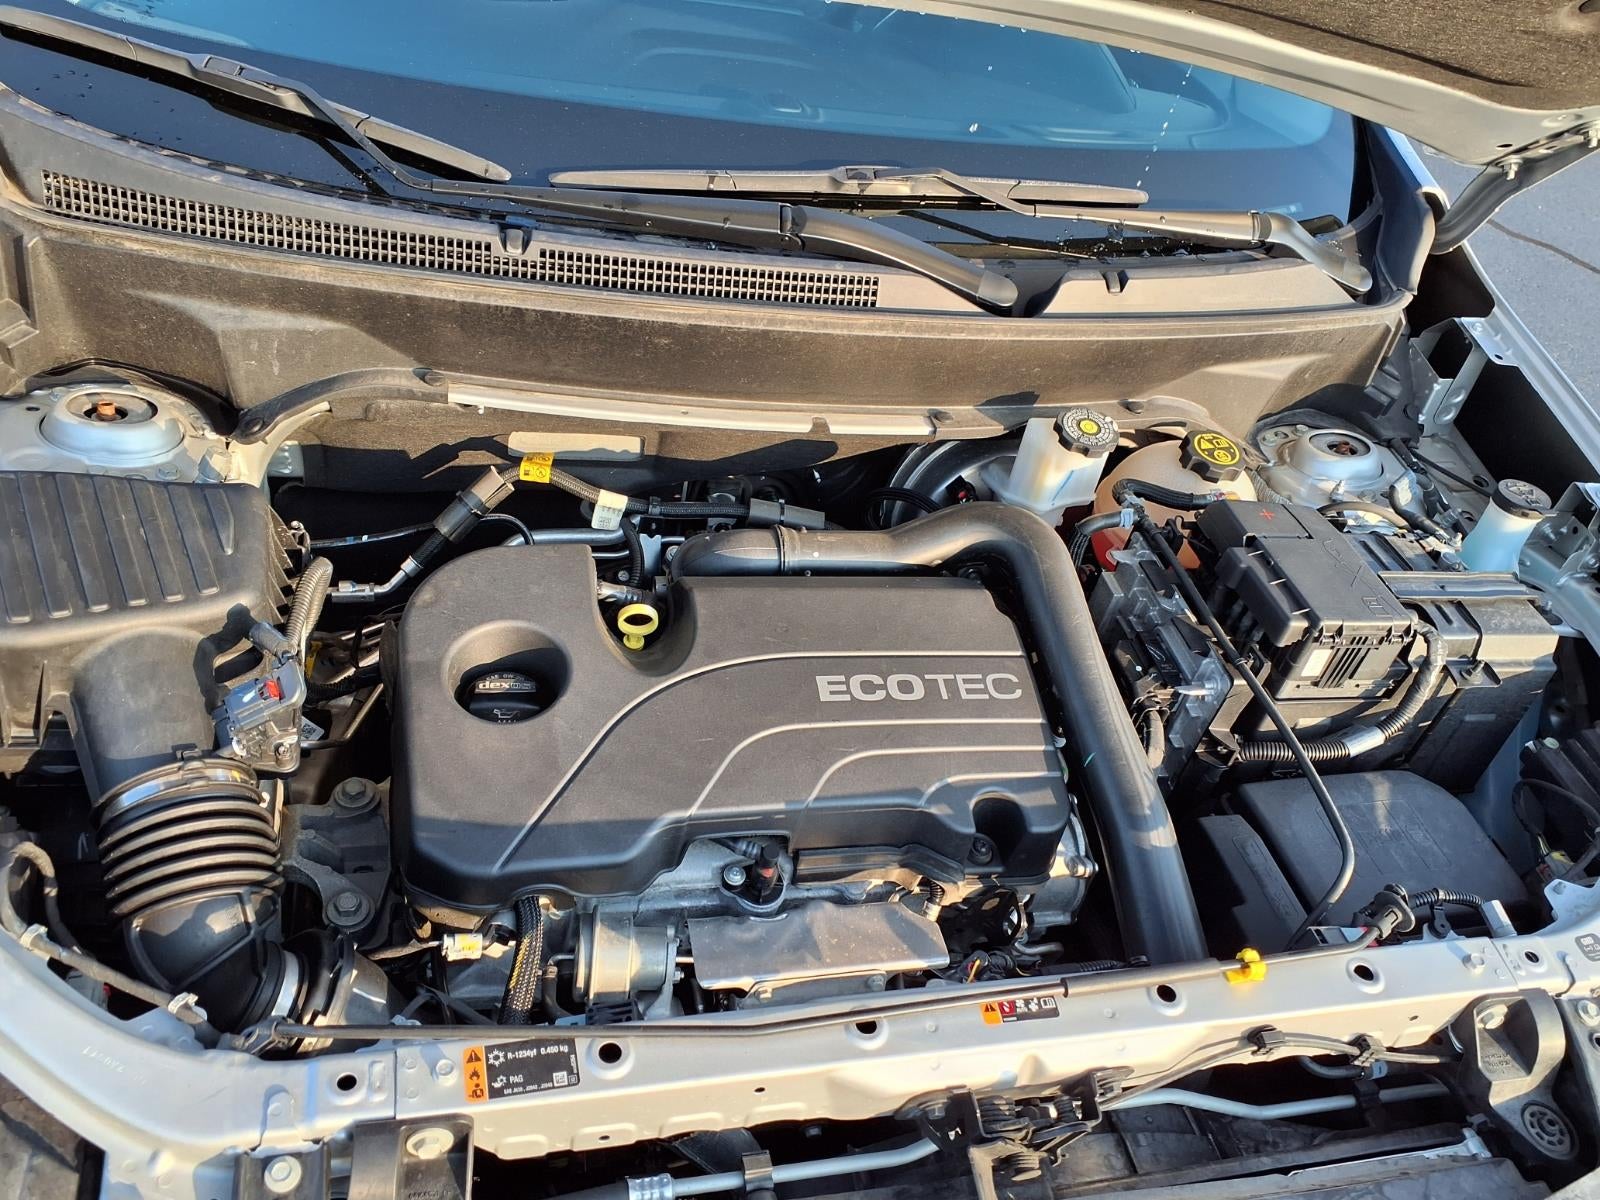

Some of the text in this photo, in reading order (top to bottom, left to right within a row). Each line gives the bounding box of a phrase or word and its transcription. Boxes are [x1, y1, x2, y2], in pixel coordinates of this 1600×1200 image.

[815, 673, 1022, 702] ECOTEC
[507, 1048, 537, 1060] R-1234yf
[559, 1045, 568, 1053] kg
[509, 1074, 524, 1084] PAG
